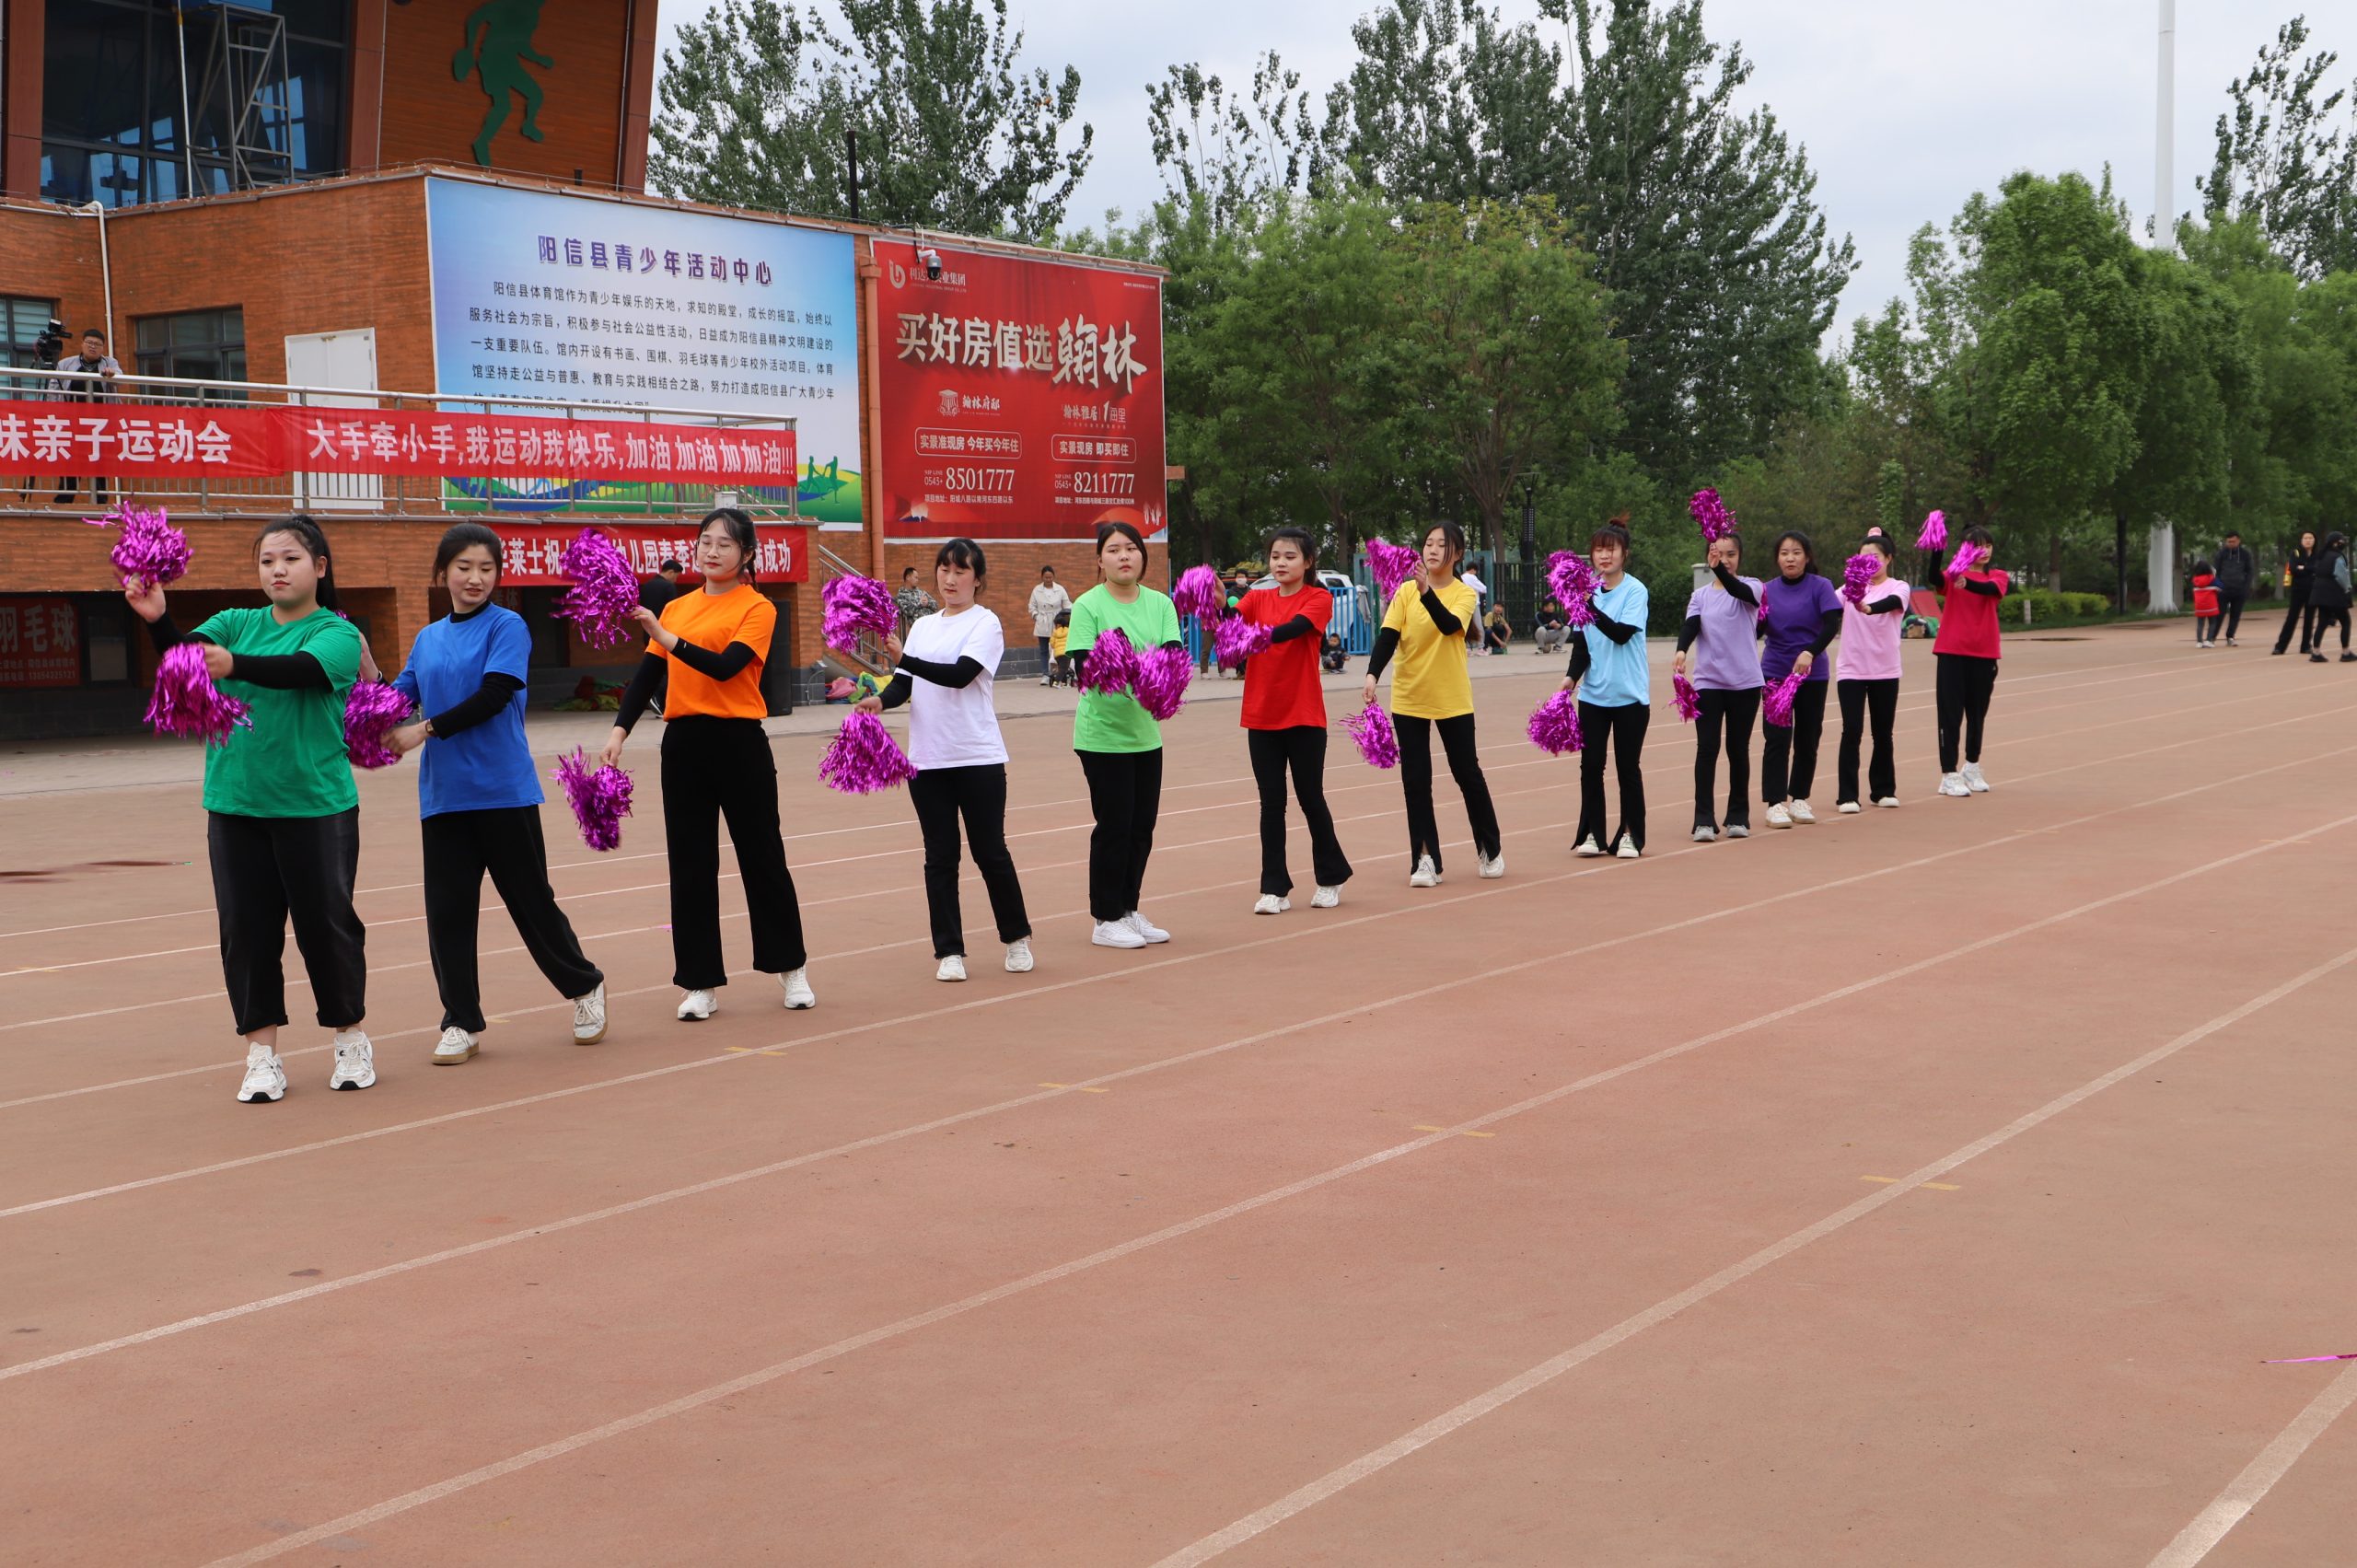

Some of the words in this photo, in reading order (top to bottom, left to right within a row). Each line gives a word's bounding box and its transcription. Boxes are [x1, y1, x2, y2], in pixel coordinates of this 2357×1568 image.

[537, 234, 773, 286] 阳信县青少年活动中心
[920, 435, 965, 450] 实景准现房
[967, 436, 1019, 453] 今年买今年住
[1060, 440, 1093, 456] 实景现房
[1096, 442, 1129, 457] 即买即住
[945, 467, 1015, 492] 8501777
[1074, 470, 1135, 494] 8211777
[0, 603, 75, 654] 羽毛球
